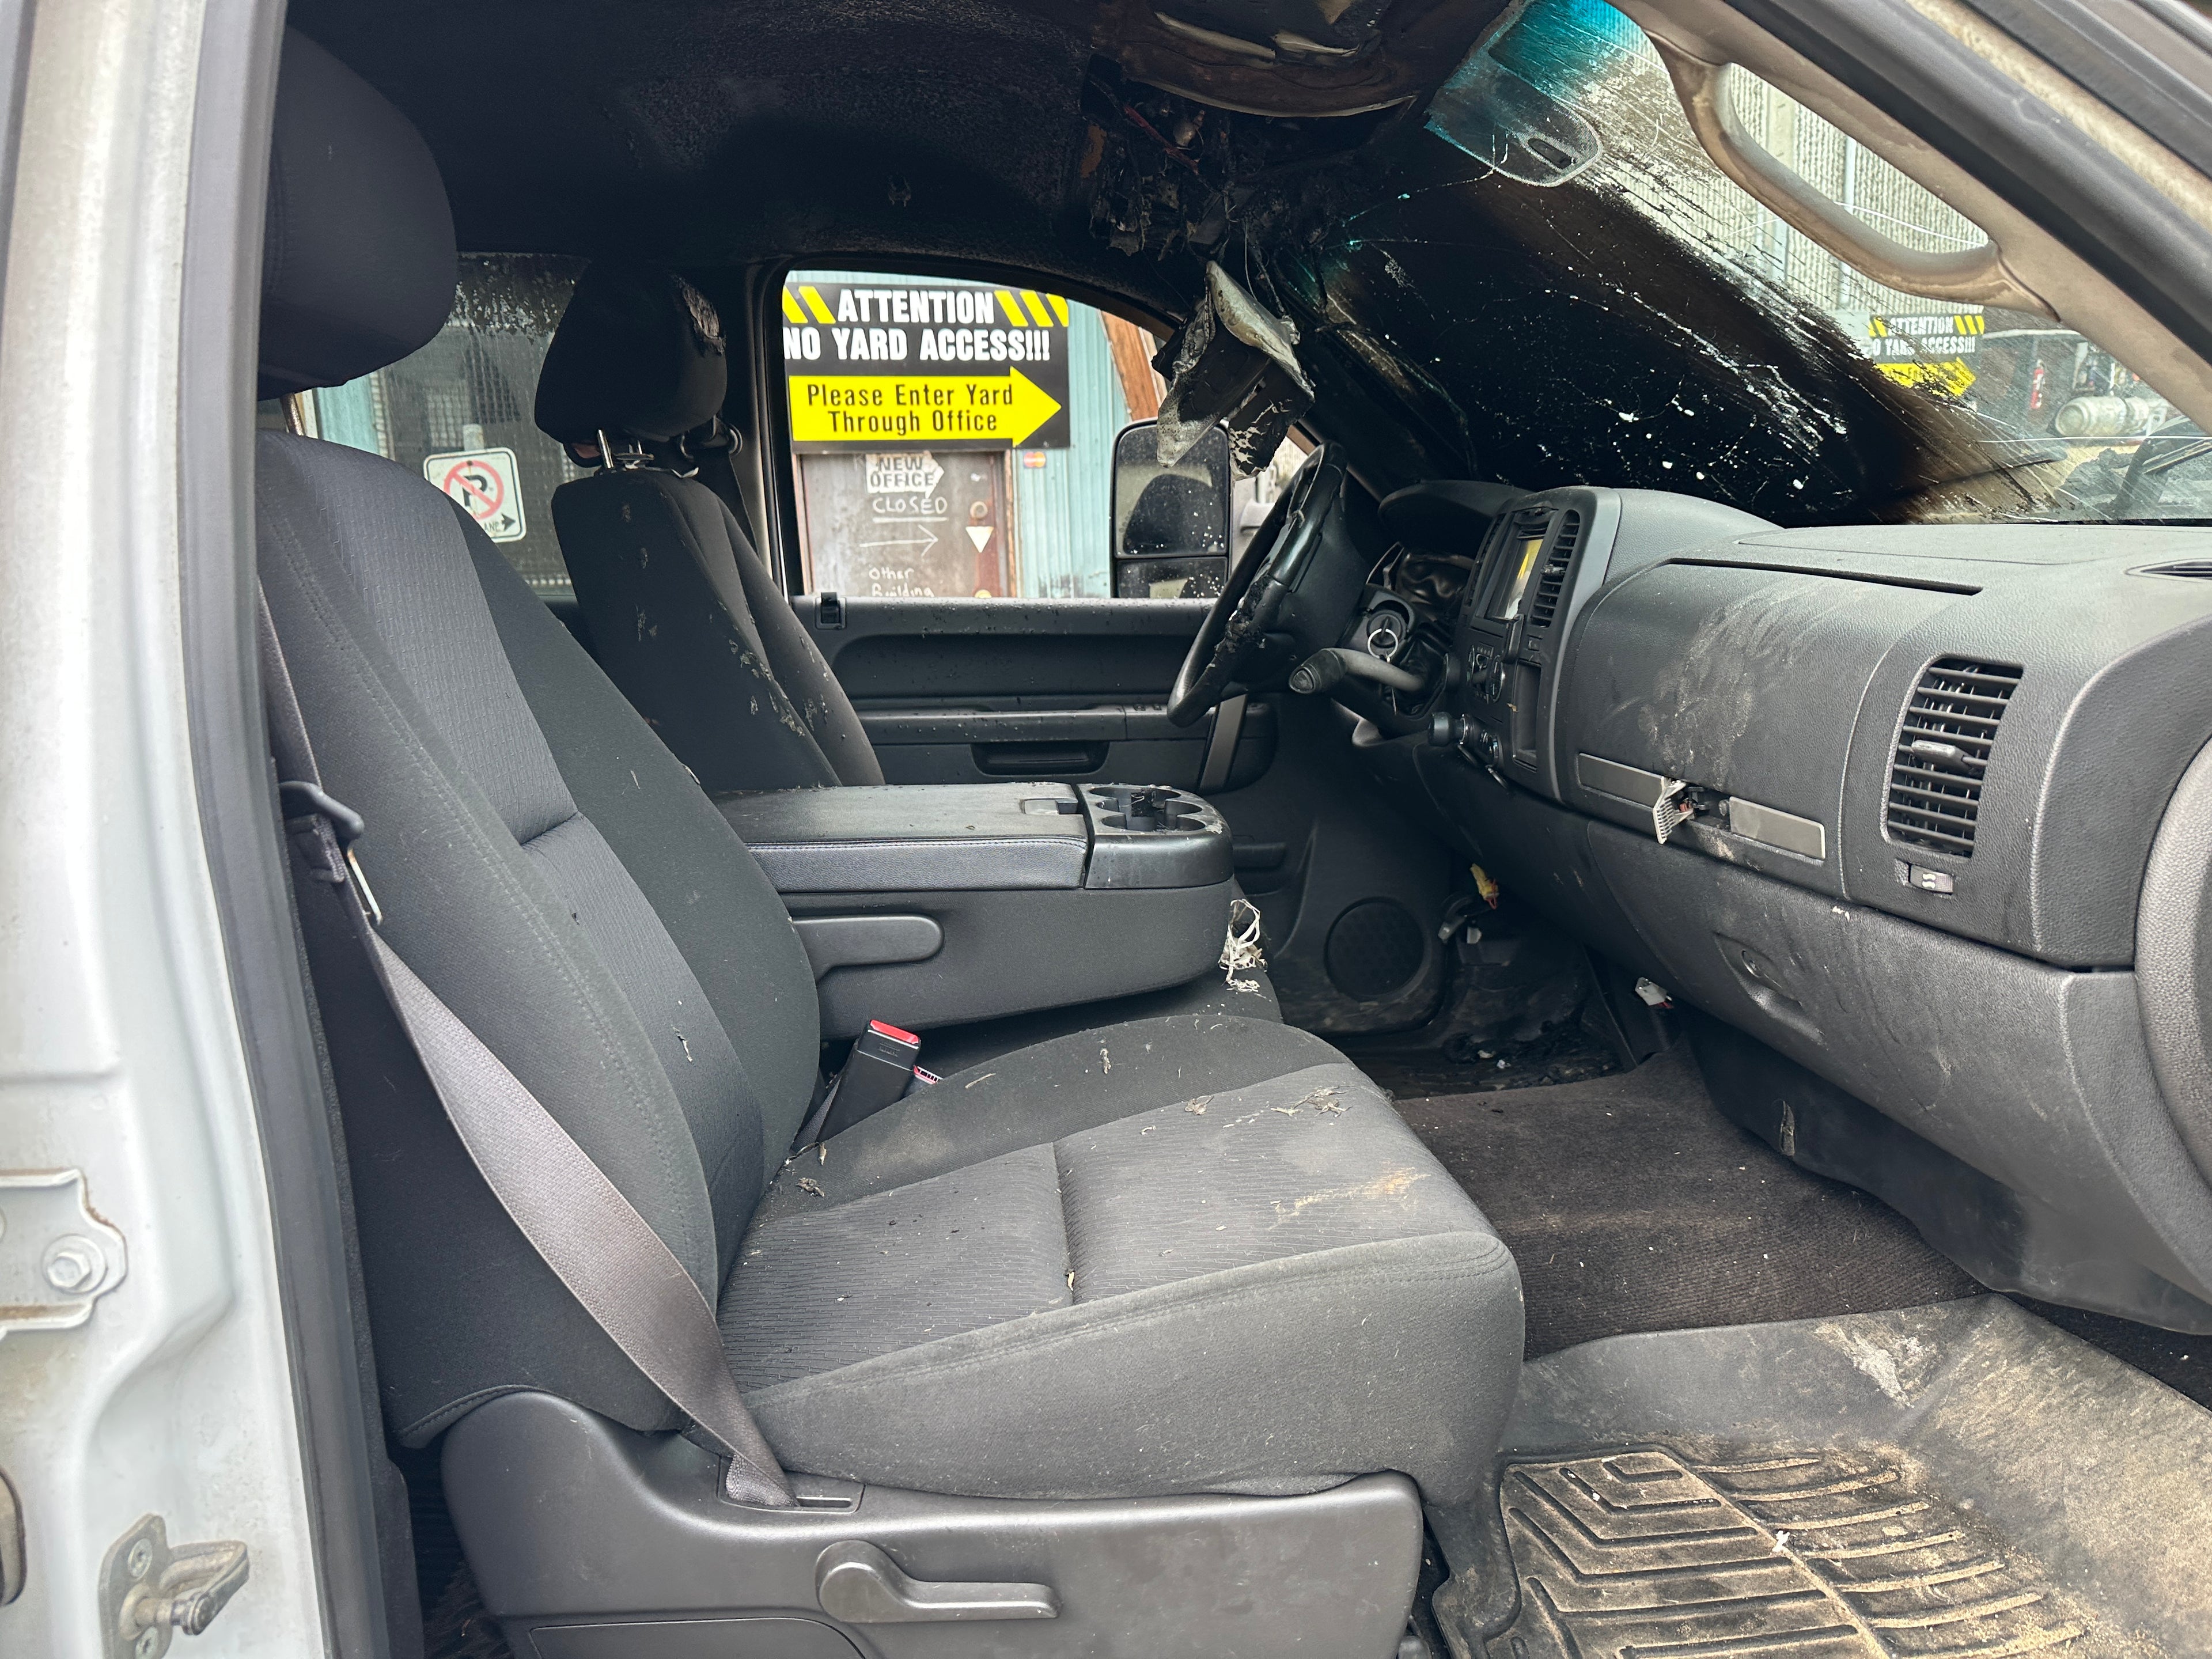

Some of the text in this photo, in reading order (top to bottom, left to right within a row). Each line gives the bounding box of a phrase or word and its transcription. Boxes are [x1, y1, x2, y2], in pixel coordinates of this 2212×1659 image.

[838, 289, 995, 323] ATTENTION
[1888, 316, 1953, 336] ATTENTION
[783, 327, 1050, 361] NO YARD ACCESS!!!
[807, 384, 1013, 406] Please Enter Yard
[828, 410, 997, 435] Through Office
[878, 457, 922, 471] NEW
[870, 471, 934, 488] OFFICE
[873, 497, 948, 514] CLOSED
[869, 567, 915, 580] Other
